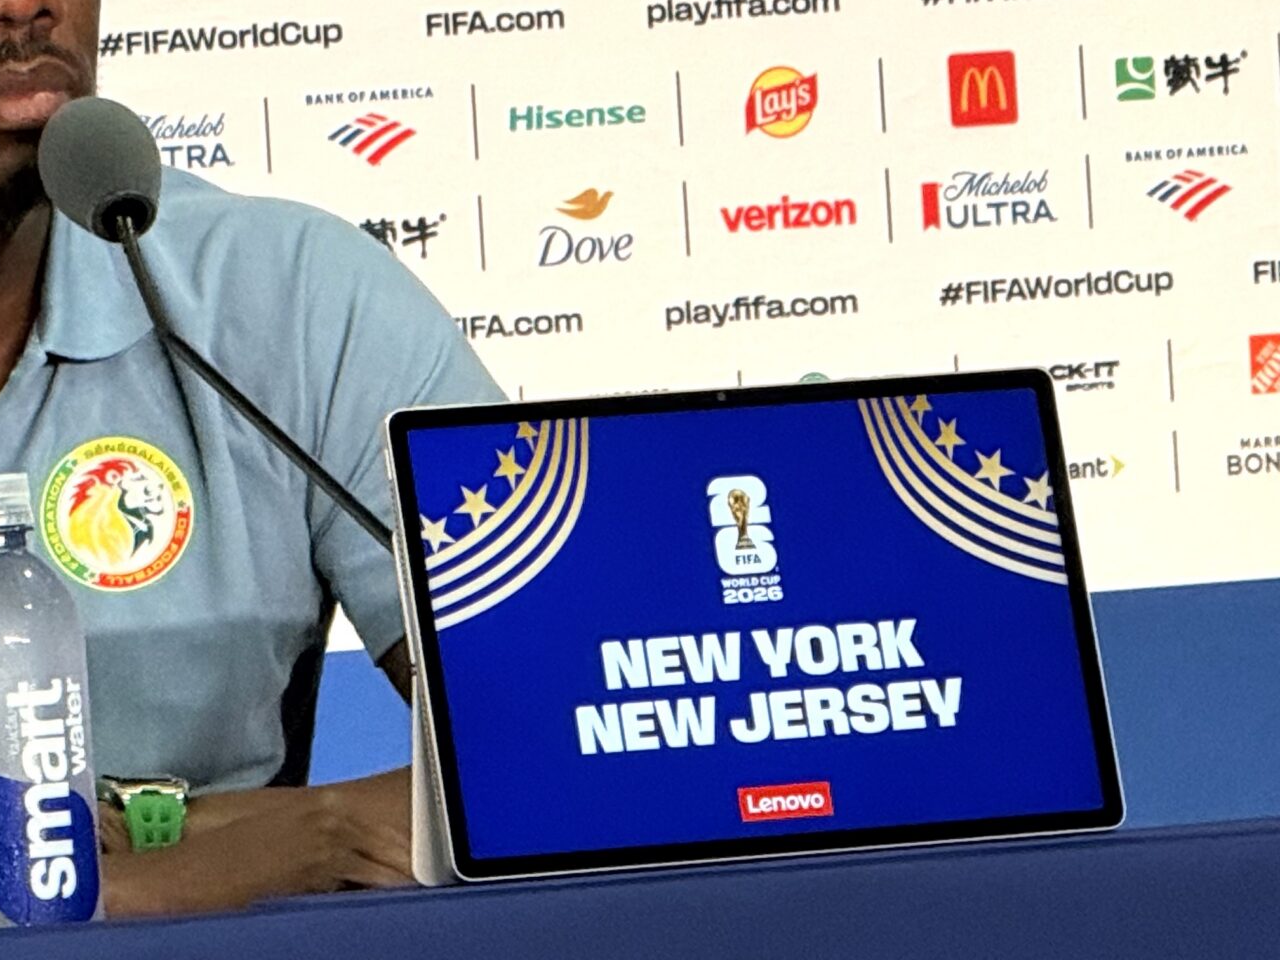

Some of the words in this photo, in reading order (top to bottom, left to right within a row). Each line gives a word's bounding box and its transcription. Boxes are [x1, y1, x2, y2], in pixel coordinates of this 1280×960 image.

[99, 21, 344, 57] #FIFAWorldCup
[426, 10, 564, 36] FIFA.com
[306, 93, 343, 105] BANK
[348, 91, 365, 103] OF
[370, 87, 433, 100] AMERICA
[754, 84, 812, 125] Lay's
[510, 105, 645, 131] Hisense
[161, 142, 231, 169] TRA
[1126, 150, 1161, 162] BANK
[1166, 148, 1182, 159] OF
[1187, 145, 1248, 157] AMERICA
[945, 170, 1048, 198] Michelob
[721, 196, 856, 232] verizon
[945, 199, 1055, 229] ULTRA
[539, 226, 633, 266] Dove
[666, 295, 858, 331] play.fifa.com
[940, 270, 1173, 306] #FIFAWorldCup
[1049, 360, 1119, 381] CK-IT
[735, 554, 762, 565] FIFA
[721, 577, 759, 588] WORLD
[760, 575, 781, 585] CUP
[723, 586, 784, 604] 2026
[600, 631, 741, 690] NEW
[751, 618, 924, 678] YORK
[64, 676, 87, 776] water
[575, 695, 716, 755] NEW
[729, 677, 962, 743] JERSEY
[6, 678, 78, 900] smart
[746, 792, 825, 814] Lenovo
